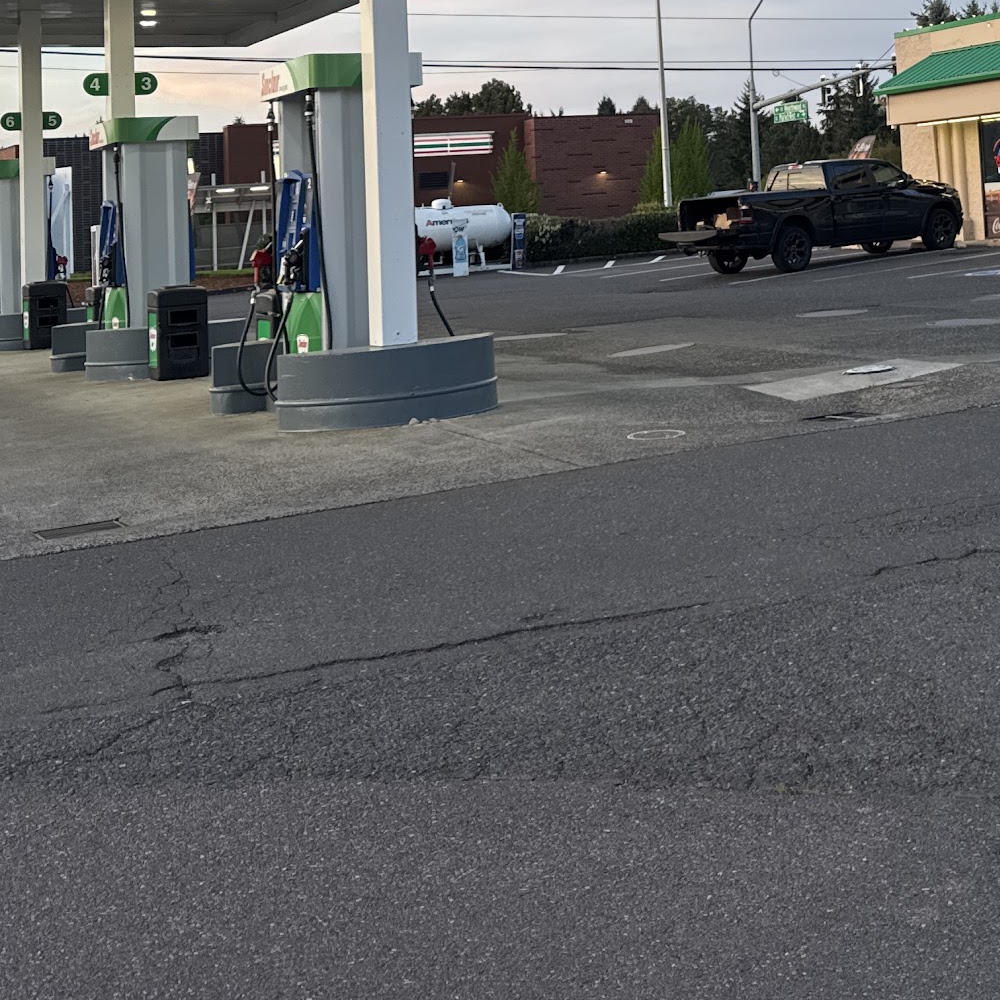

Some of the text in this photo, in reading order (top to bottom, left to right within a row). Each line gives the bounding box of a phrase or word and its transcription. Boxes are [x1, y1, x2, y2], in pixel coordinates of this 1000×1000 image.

[90, 78, 100, 90] 4
[141, 77, 152, 90] 3
[5, 116, 15, 127] 6
[48, 114, 57, 127] 5
[307, 178, 312, 189] 2
